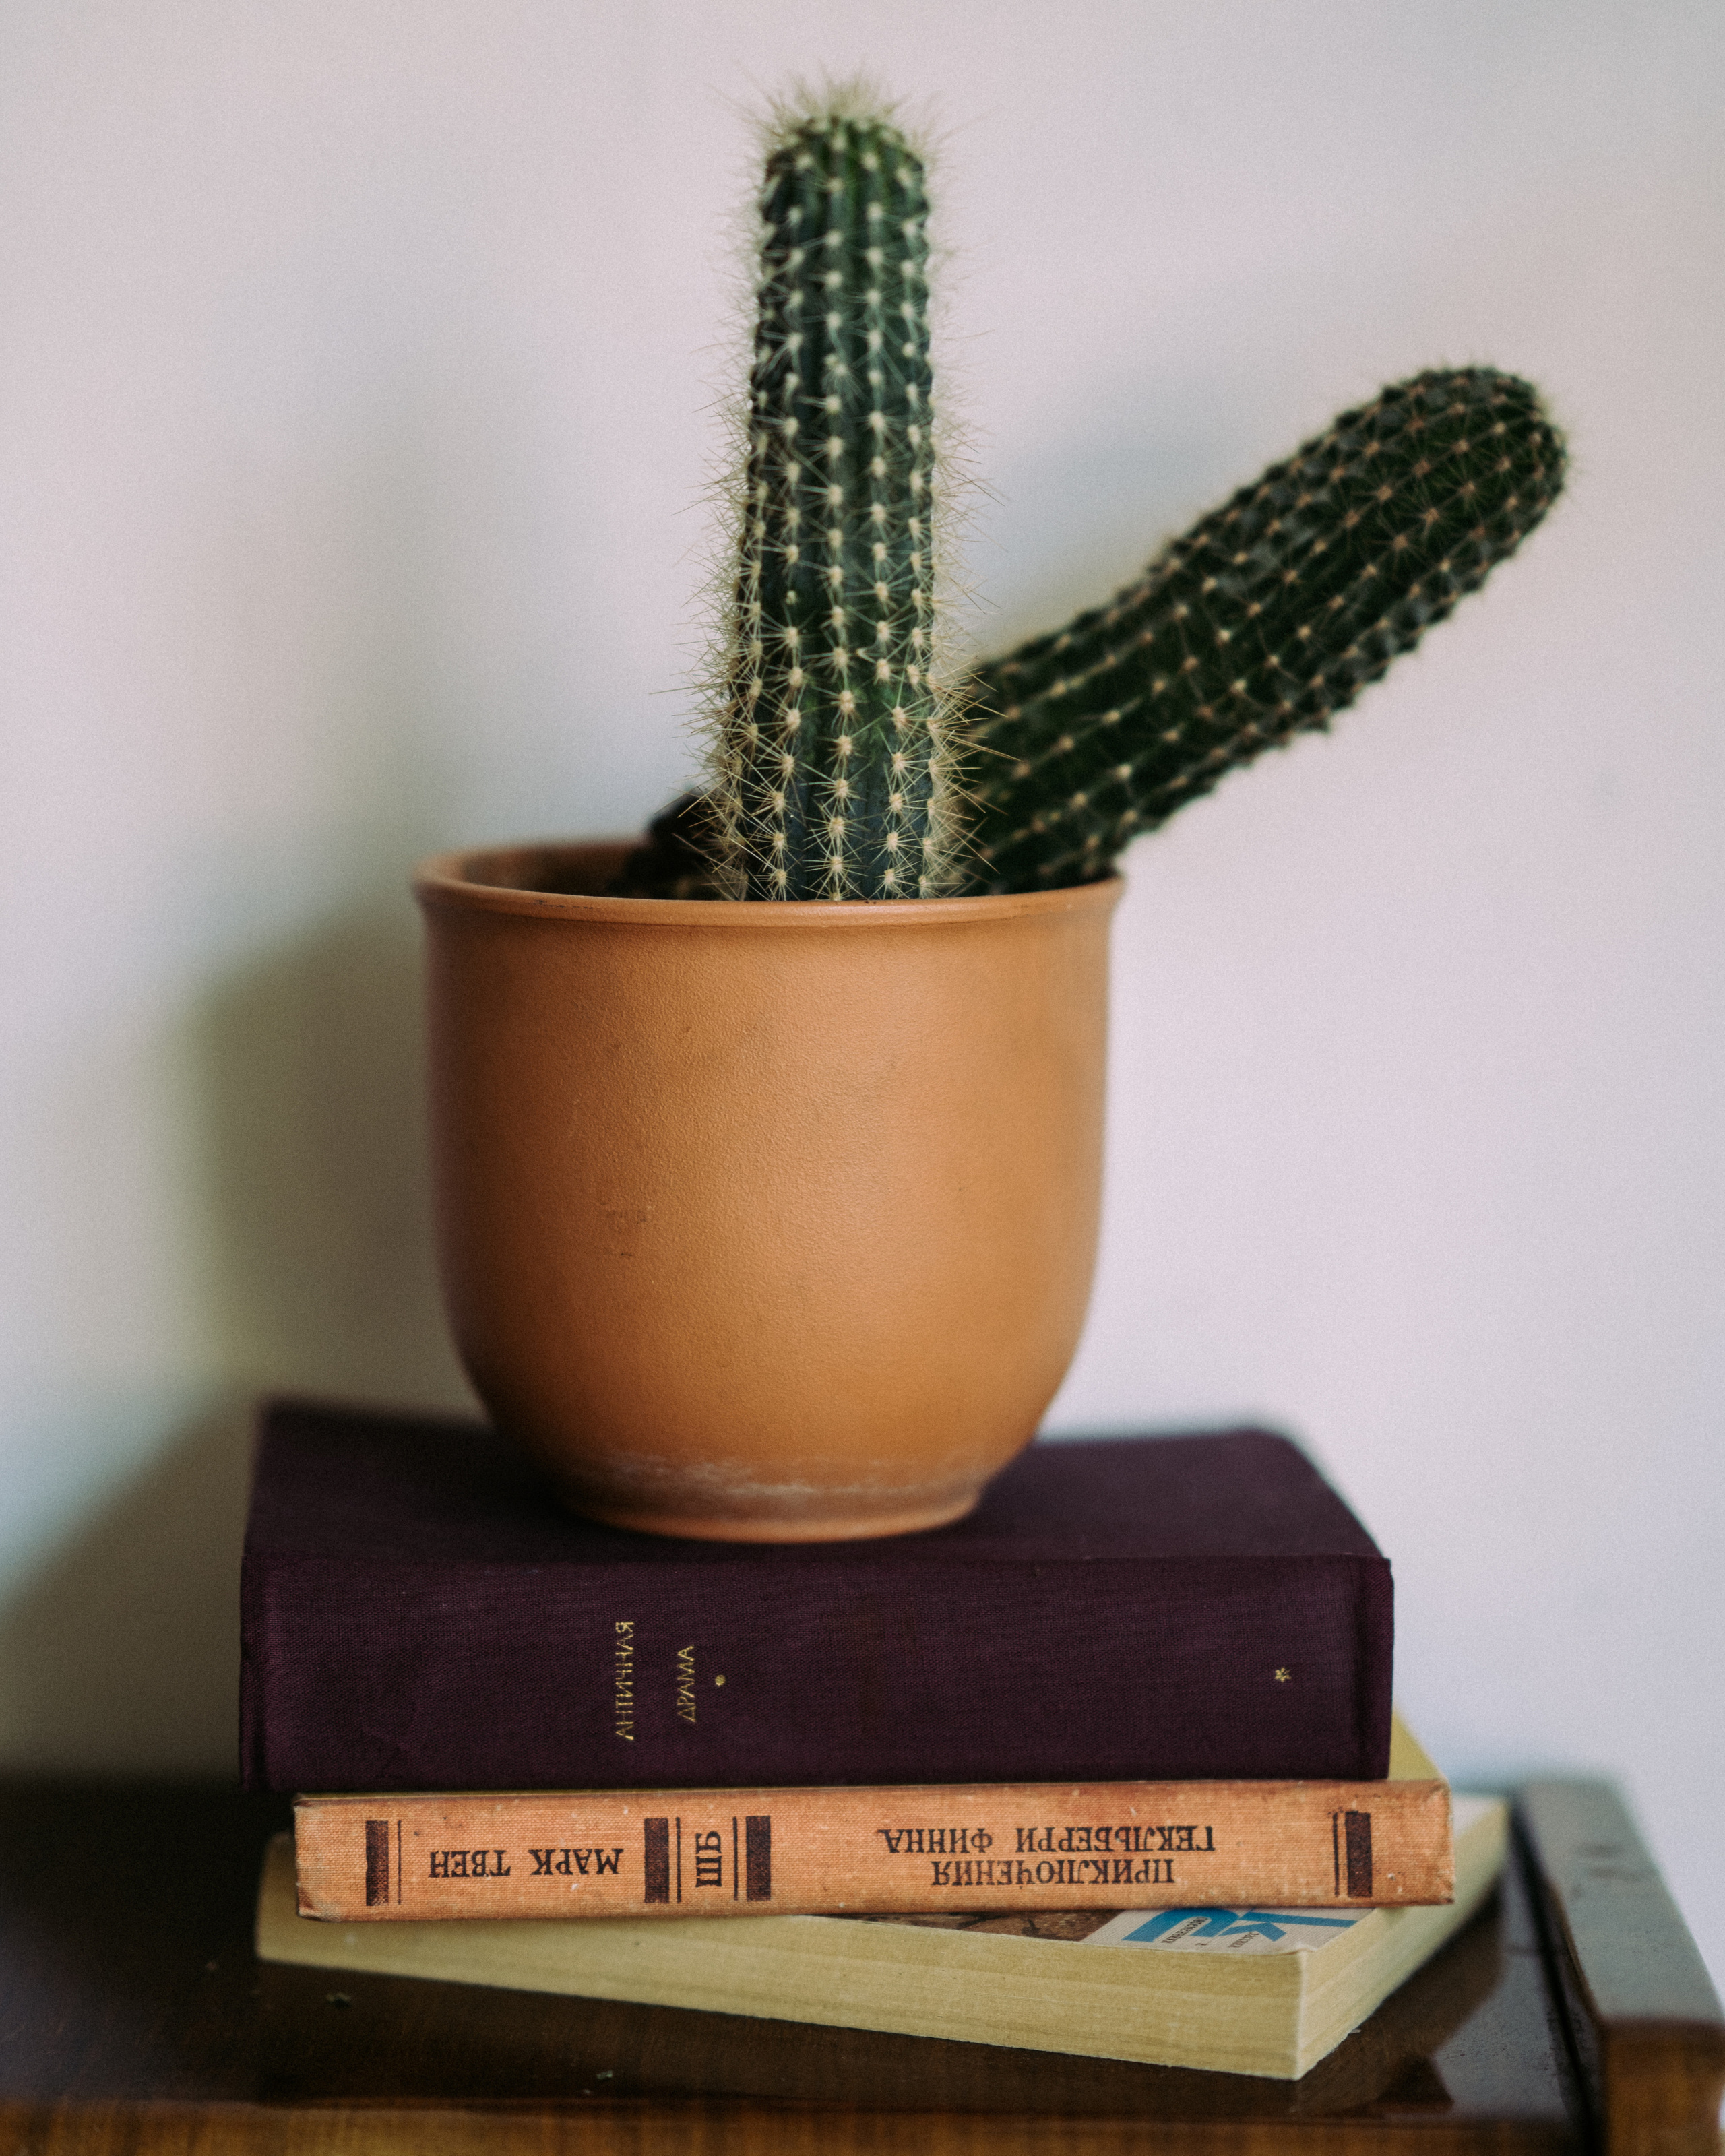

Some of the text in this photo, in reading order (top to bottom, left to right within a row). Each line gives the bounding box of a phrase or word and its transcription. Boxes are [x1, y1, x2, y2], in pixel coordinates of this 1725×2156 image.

[615, 1622, 635, 1740] АНТИЧНАЯ
[677, 1645, 697, 1723] ДРАМА
[695, 1830, 722, 1887] ШБ
[877, 1825, 1216, 1853] ГЕКЛЬБЕРРИ ФИННА
[428, 1848, 624, 1878] МАРК ТВЕН
[930, 1858, 1176, 1886] ПРИКЛЮЧЕНИЯ
